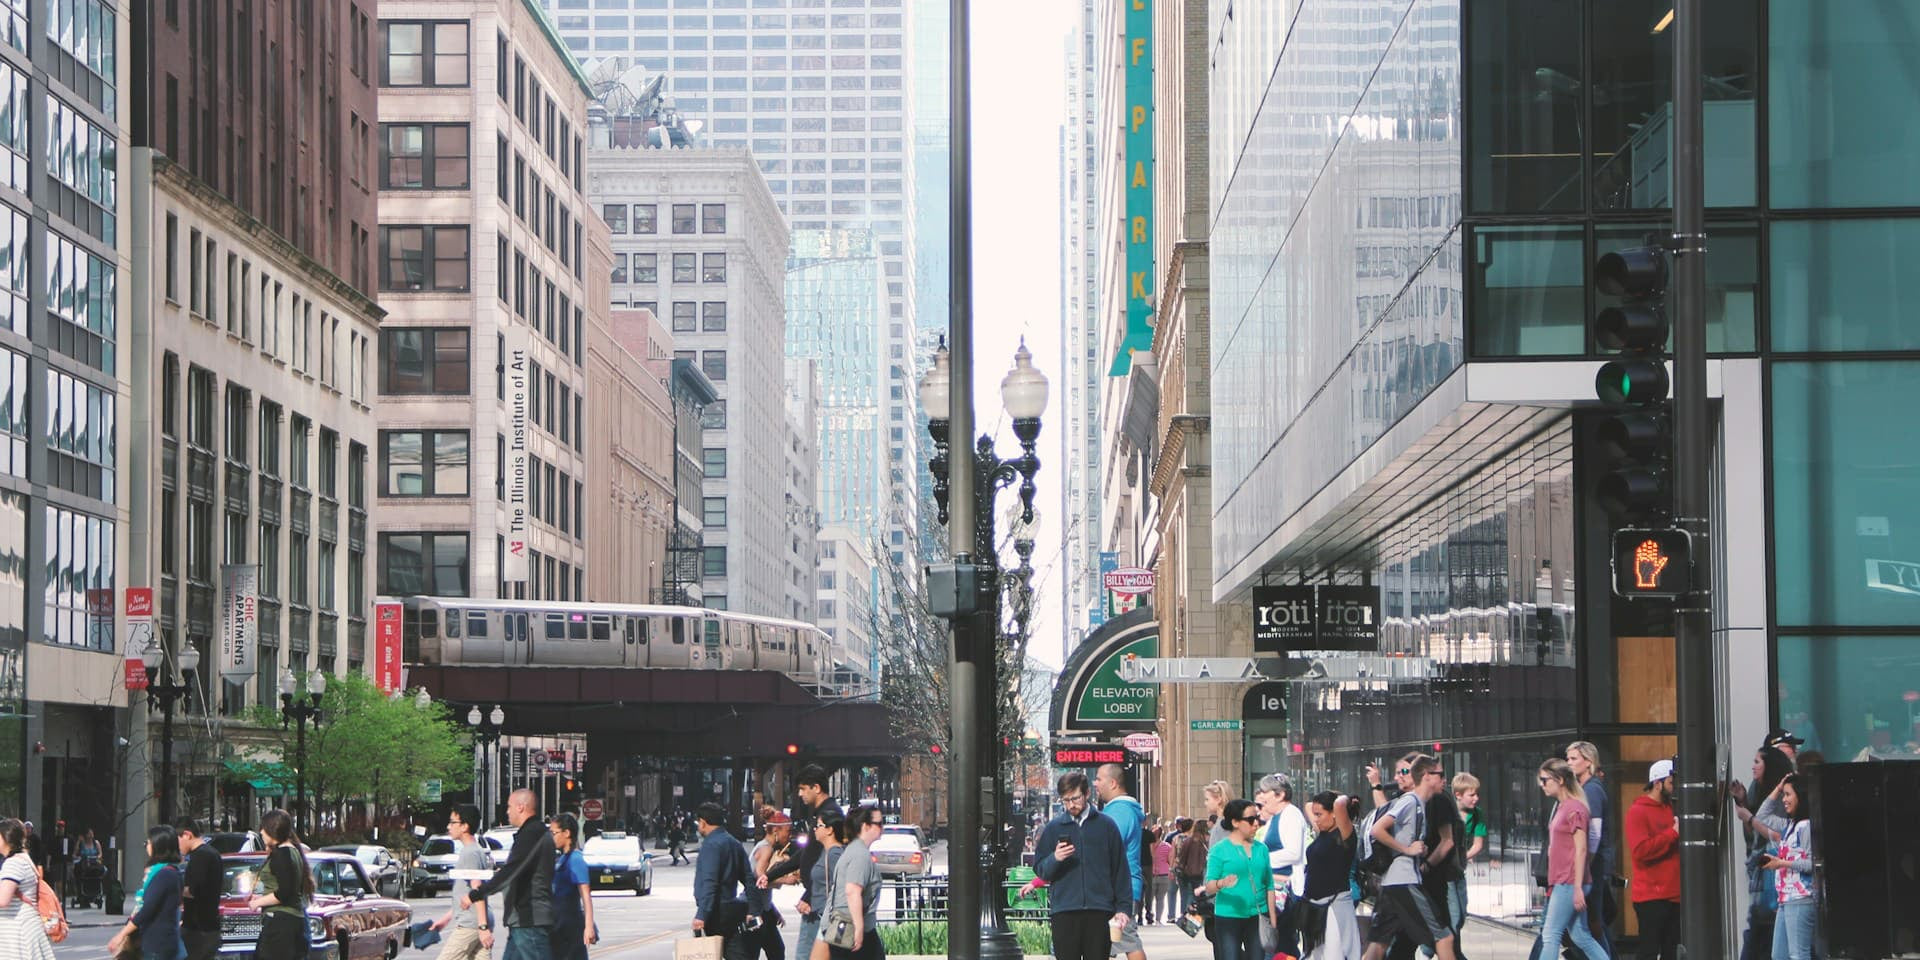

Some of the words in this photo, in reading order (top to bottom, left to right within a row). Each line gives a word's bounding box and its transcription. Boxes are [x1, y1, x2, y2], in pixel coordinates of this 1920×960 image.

[1132, 105, 1147, 299] PARK
[511, 350, 524, 371] Art
[511, 376, 524, 388] of
[511, 393, 524, 451] Institute
[511, 456, 524, 504] Illinois
[511, 509, 524, 533] The
[1106, 575, 1129, 586] BILLY
[1136, 575, 1154, 586] GOA
[128, 623, 150, 644] 73
[234, 594, 244, 666] APARTMENTS
[1139, 658, 1213, 678] MILA
[1092, 687, 1154, 698] ELEVATOR
[1104, 703, 1143, 714] LOBBY
[1197, 721, 1231, 729] GARLAND
[1056, 750, 1093, 763] ENTER
[1094, 750, 1124, 763] HERE
